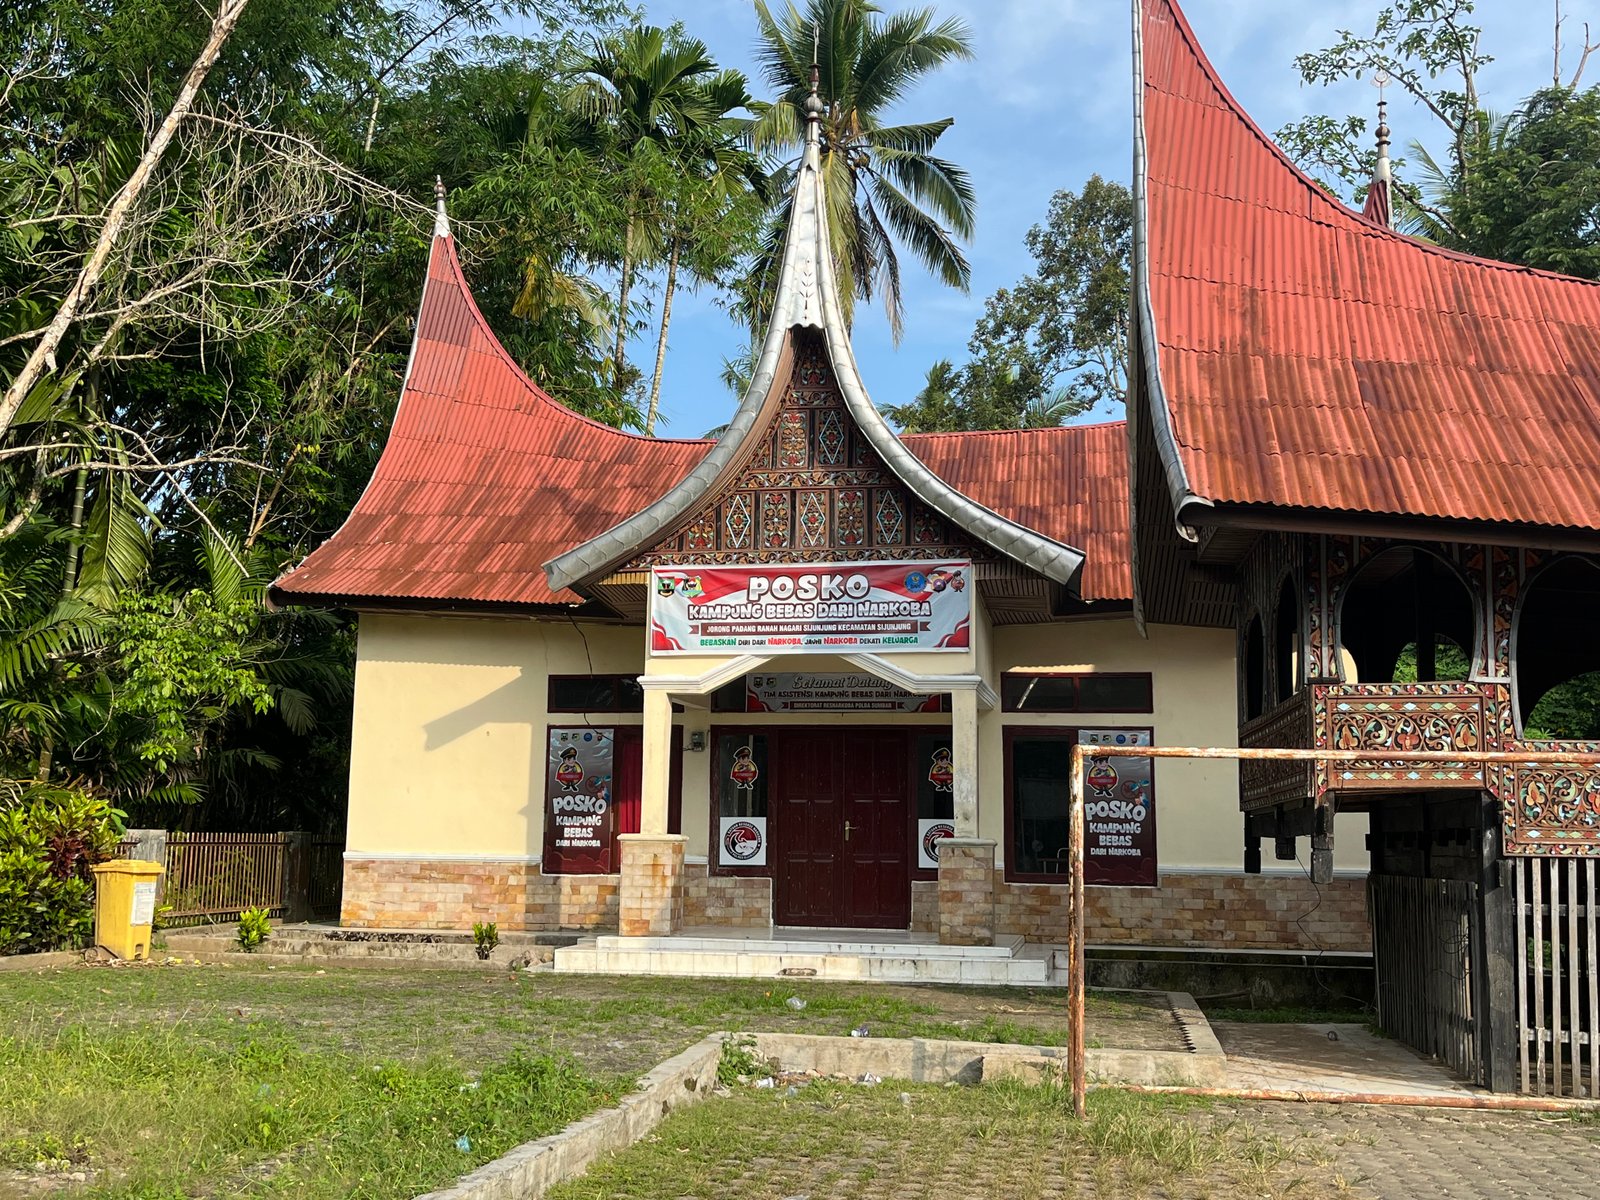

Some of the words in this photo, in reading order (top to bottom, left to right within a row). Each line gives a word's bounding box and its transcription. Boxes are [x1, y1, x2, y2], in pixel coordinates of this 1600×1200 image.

[748, 574, 870, 602] POSKO
[688, 603, 762, 619] KAMPUNG
[765, 602, 815, 619] BEBAS
[818, 602, 854, 618] DARI
[857, 600, 932, 617] NARKOBA
[707, 624, 730, 633] JORONG
[732, 624, 755, 632] PADANG
[757, 624, 778, 632] RANAH
[779, 624, 802, 632] NAGARI
[803, 623, 837, 632] SIJUNJUNG
[838, 623, 876, 631] KECAMATAN
[877, 622, 912, 631] SIJUNJUNG
[700, 637, 737, 646] BEBASKAN
[823, 636, 858, 644] NARKOBA
[882, 636, 918, 644] KELUARGA
[792, 675, 845, 689] Selamat
[847, 675, 893, 690] Datang
[778, 690, 813, 698] ASISTENSI
[815, 690, 850, 698] KAMPUNG
[552, 795, 607, 814] POSKO
[1085, 800, 1146, 821] POSKO
[556, 815, 602, 826] KAMPUNG
[563, 827, 594, 838] BEBAS
[1089, 822, 1141, 833] KAMPUNG
[555, 839, 571, 847] DARI
[571, 839, 601, 847] NARKOBA
[1098, 835, 1132, 846] BEBAS
[1090, 847, 1107, 855] DARI
[1108, 847, 1141, 856] NARKOBA
